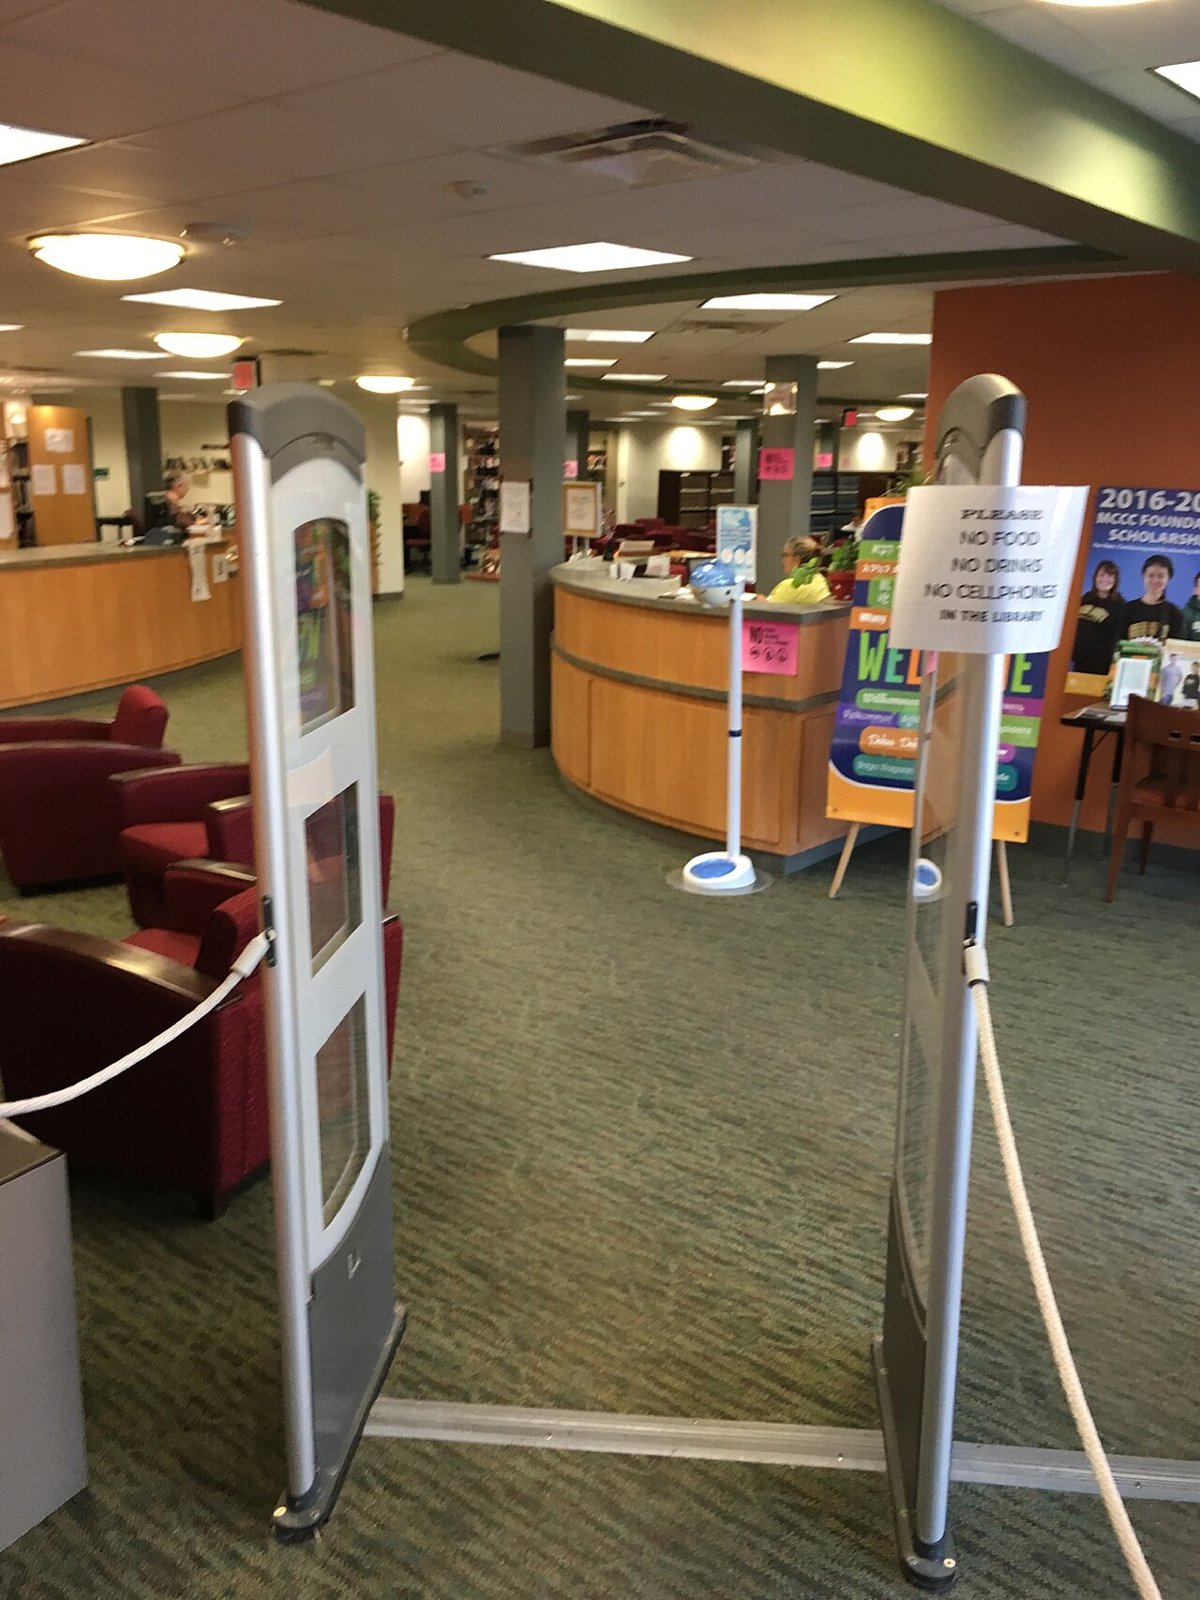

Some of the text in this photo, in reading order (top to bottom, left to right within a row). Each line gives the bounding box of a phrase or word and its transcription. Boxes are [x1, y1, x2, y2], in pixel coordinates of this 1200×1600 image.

[960, 509, 1044, 520] PLEASE
[1096, 512, 1139, 526] MCCC
[959, 530, 1041, 546] NO FOOD
[951, 557, 1043, 573] NO DRINKS
[924, 583, 1058, 600] NO CELLPHONES
[939, 609, 1044, 622] IN THE LIBRARY
[857, 630, 1033, 693] WELE
